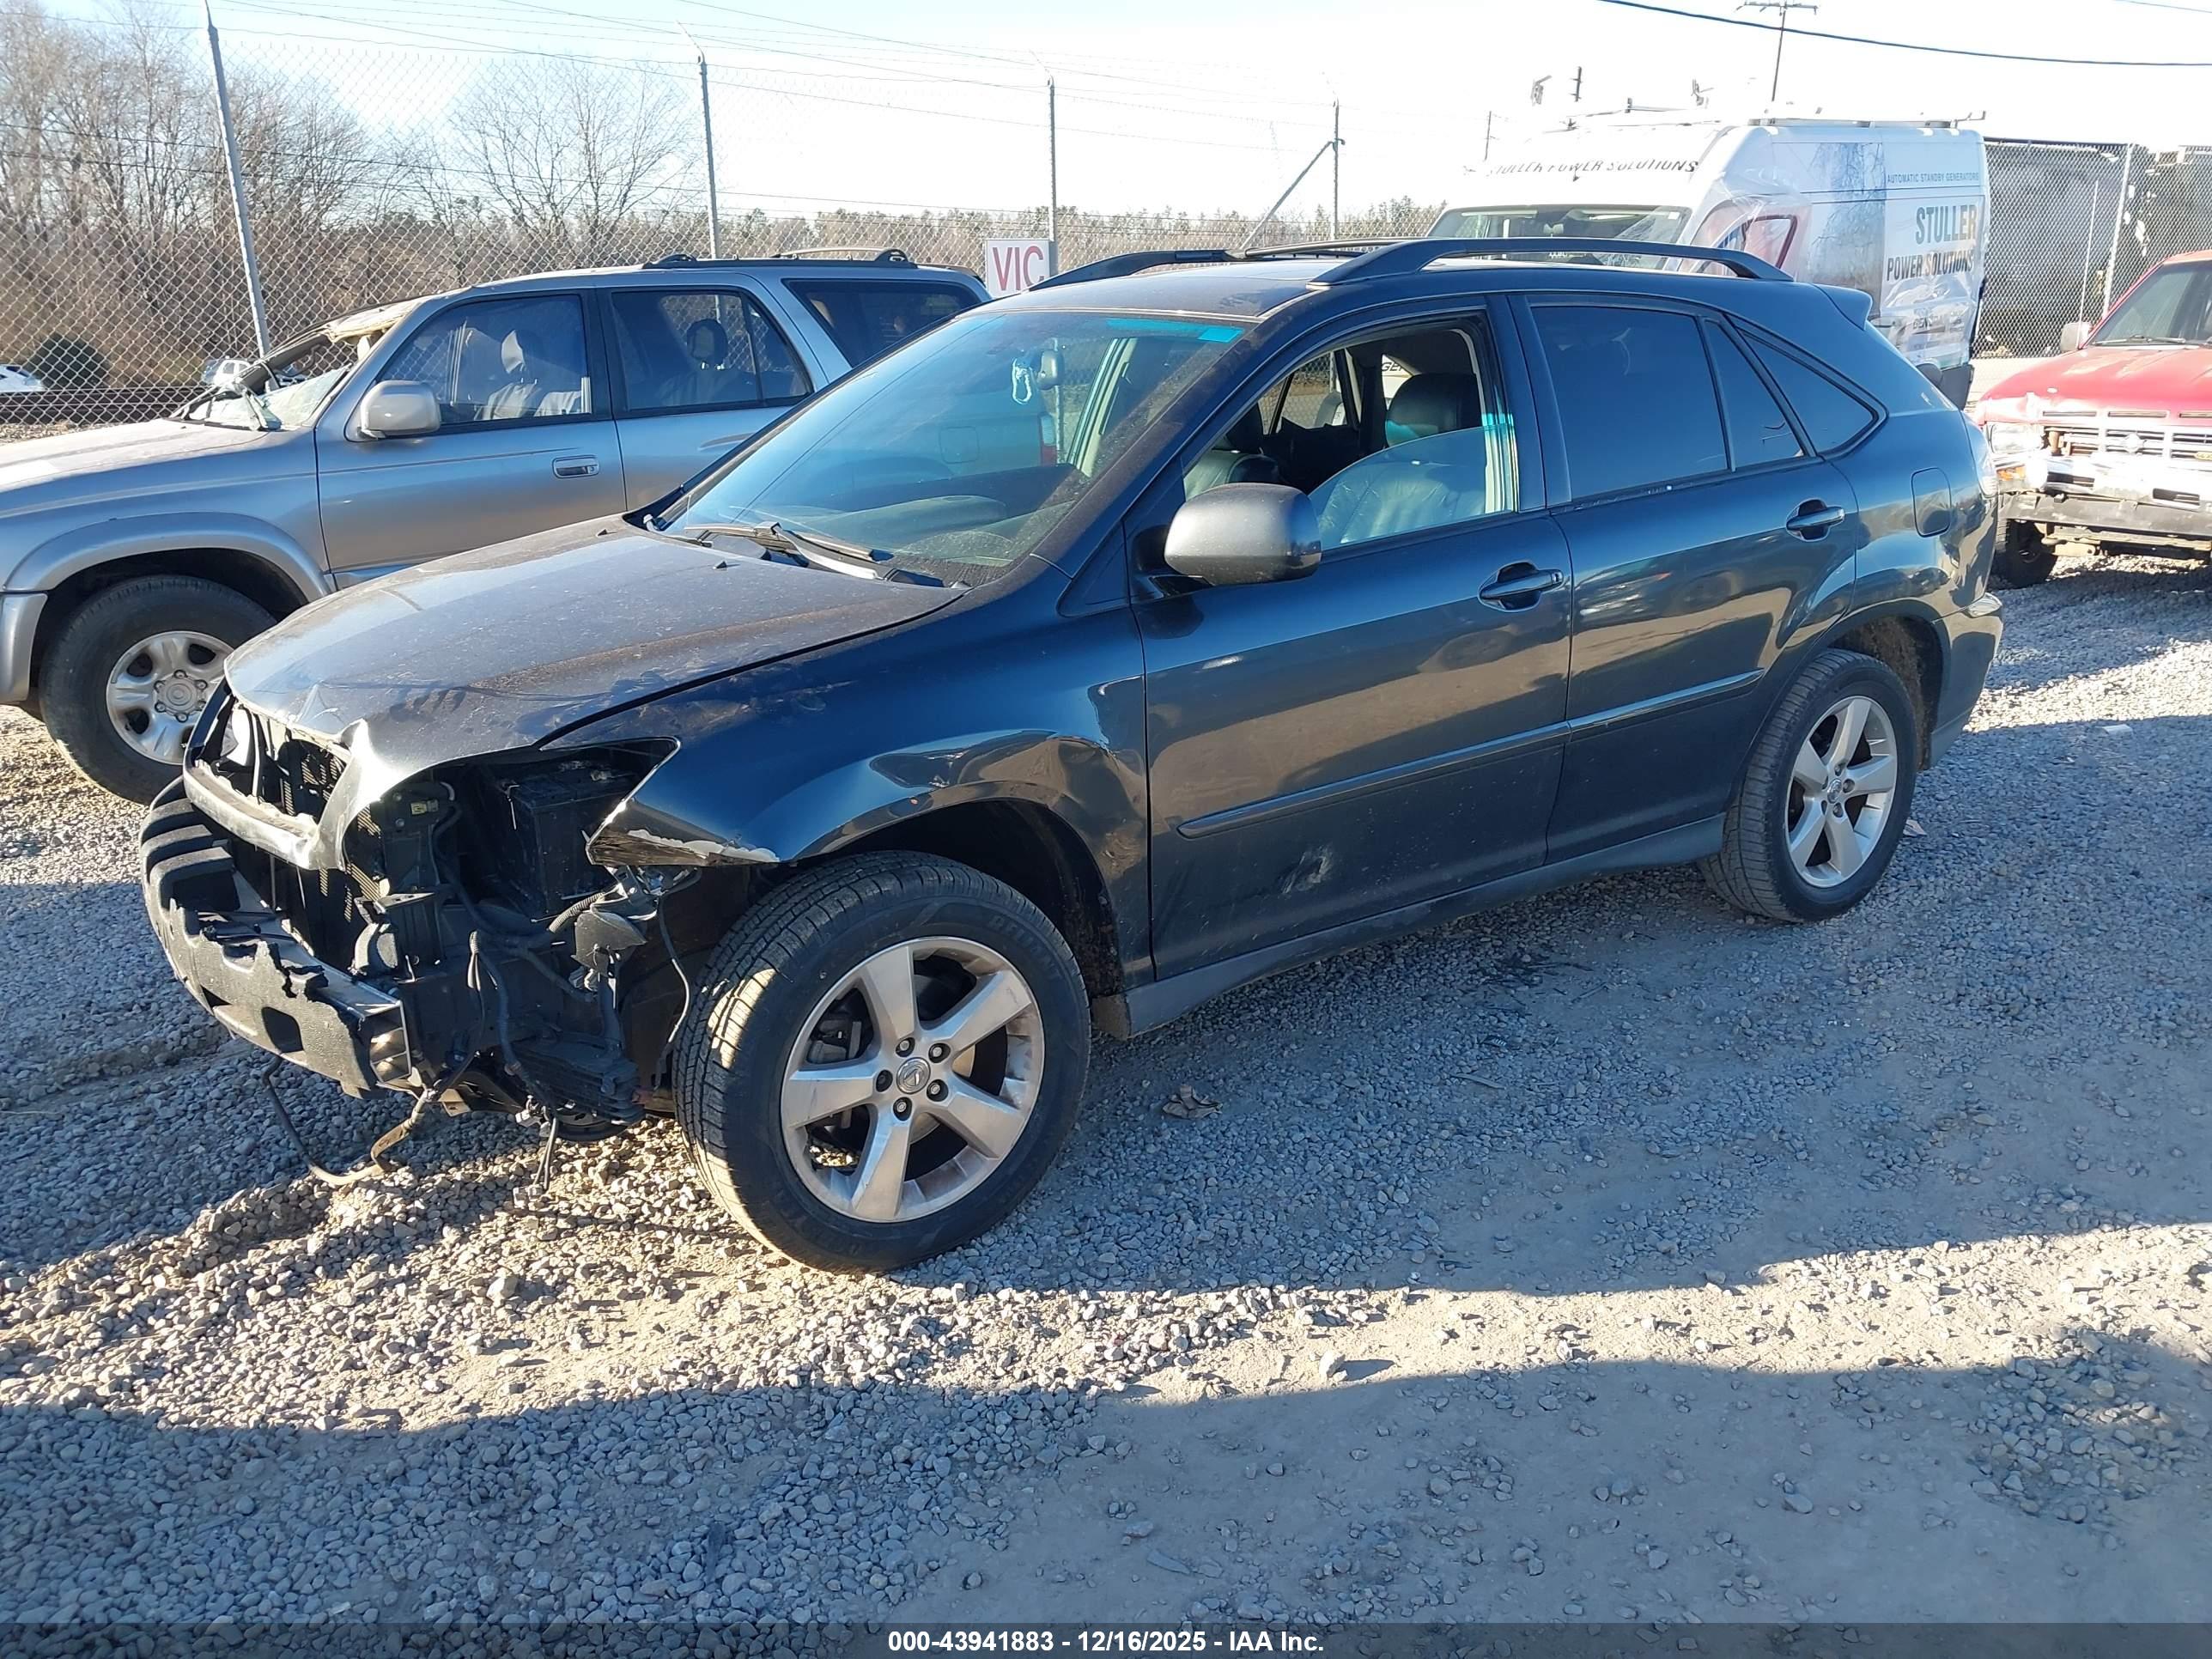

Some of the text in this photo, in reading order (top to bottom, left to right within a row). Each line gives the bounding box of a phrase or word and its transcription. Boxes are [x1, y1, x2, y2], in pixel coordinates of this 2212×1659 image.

[1607, 158, 1699, 173] SOLUTIONS
[1887, 173, 1919, 183] AUTOMATIC
[1920, 173, 1945, 182] STANDBY
[1916, 205, 1977, 245] STULLER
[992, 246, 1045, 291] VIC
[1887, 249, 1974, 281] POWER SOLUTIONS
